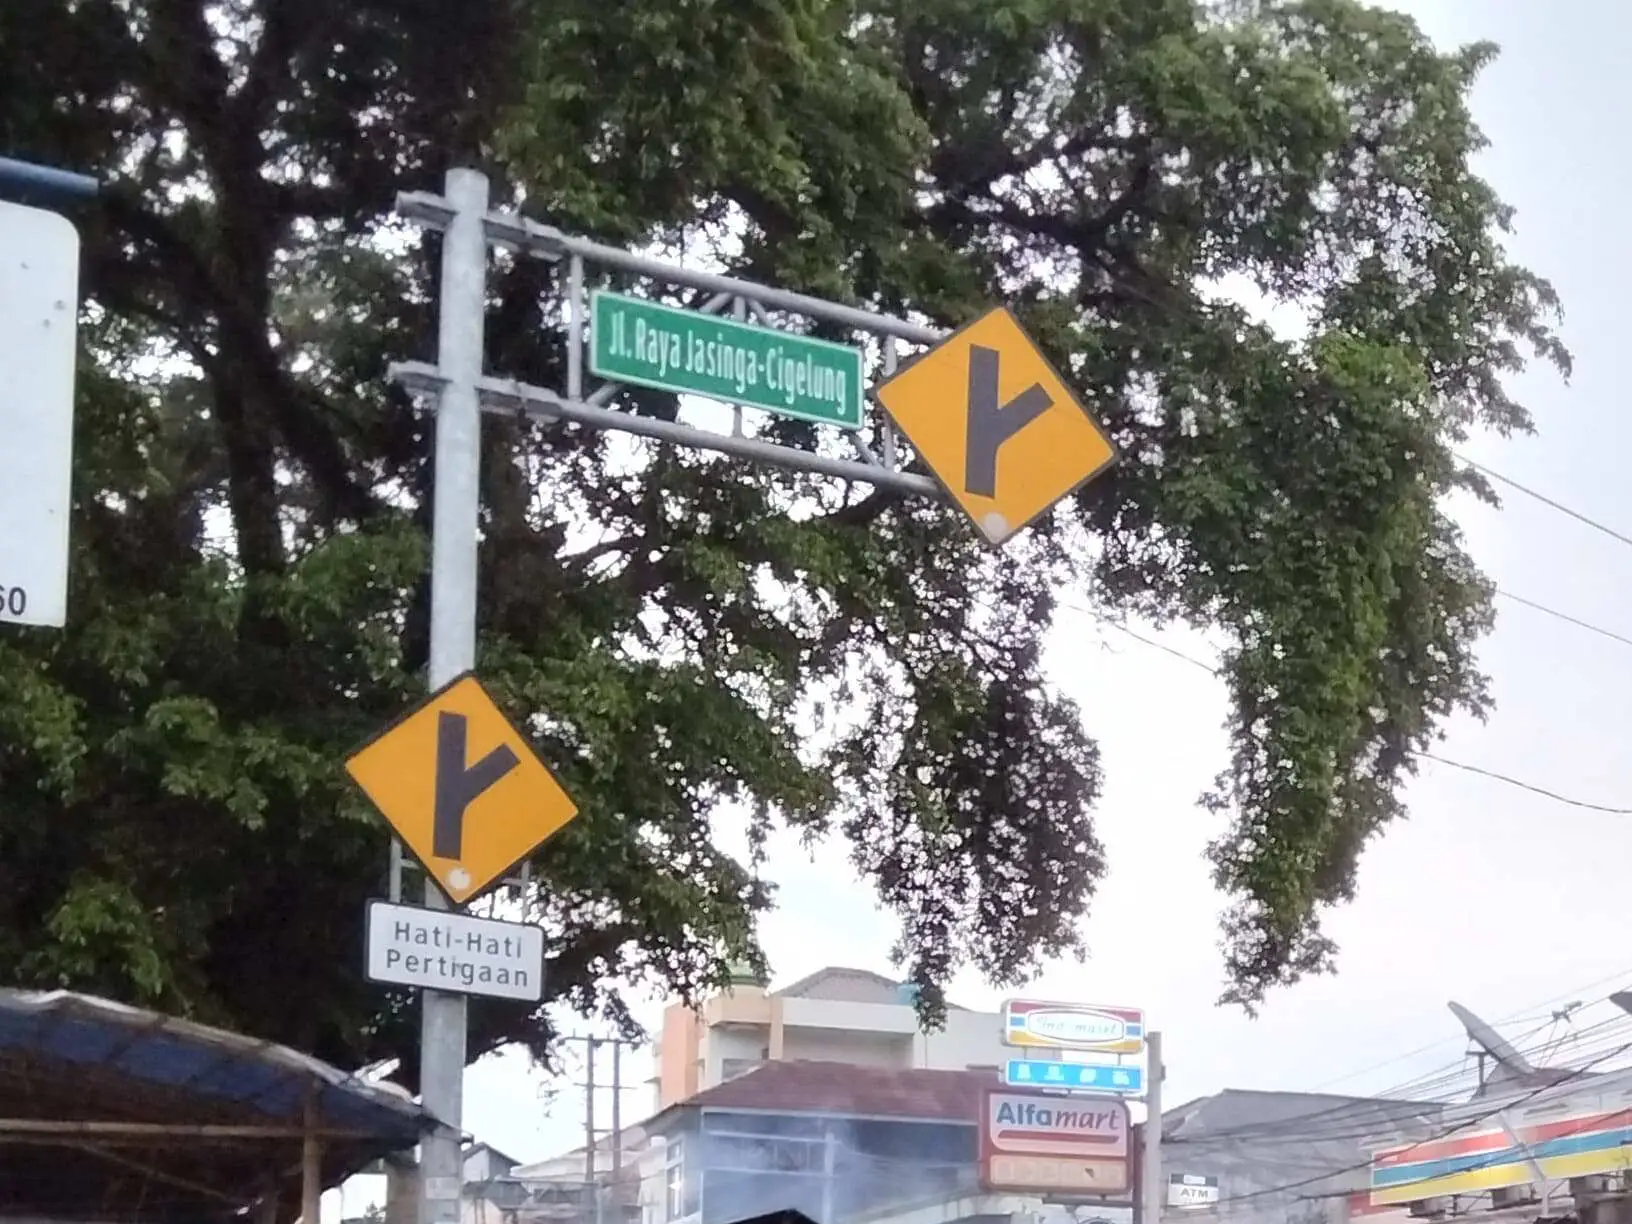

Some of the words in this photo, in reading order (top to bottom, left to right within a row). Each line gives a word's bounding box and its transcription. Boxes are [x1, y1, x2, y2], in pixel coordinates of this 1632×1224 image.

[609, 309, 632, 357] Jl.
[636, 317, 681, 378] Raya
[684, 330, 847, 415] Jasinga-Cigelung
[394, 920, 523, 959] Hati-Hati
[386, 948, 529, 986] Pertigaan
[996, 1102, 1120, 1130] Alfamart
[1180, 1187, 1208, 1198] ATM
